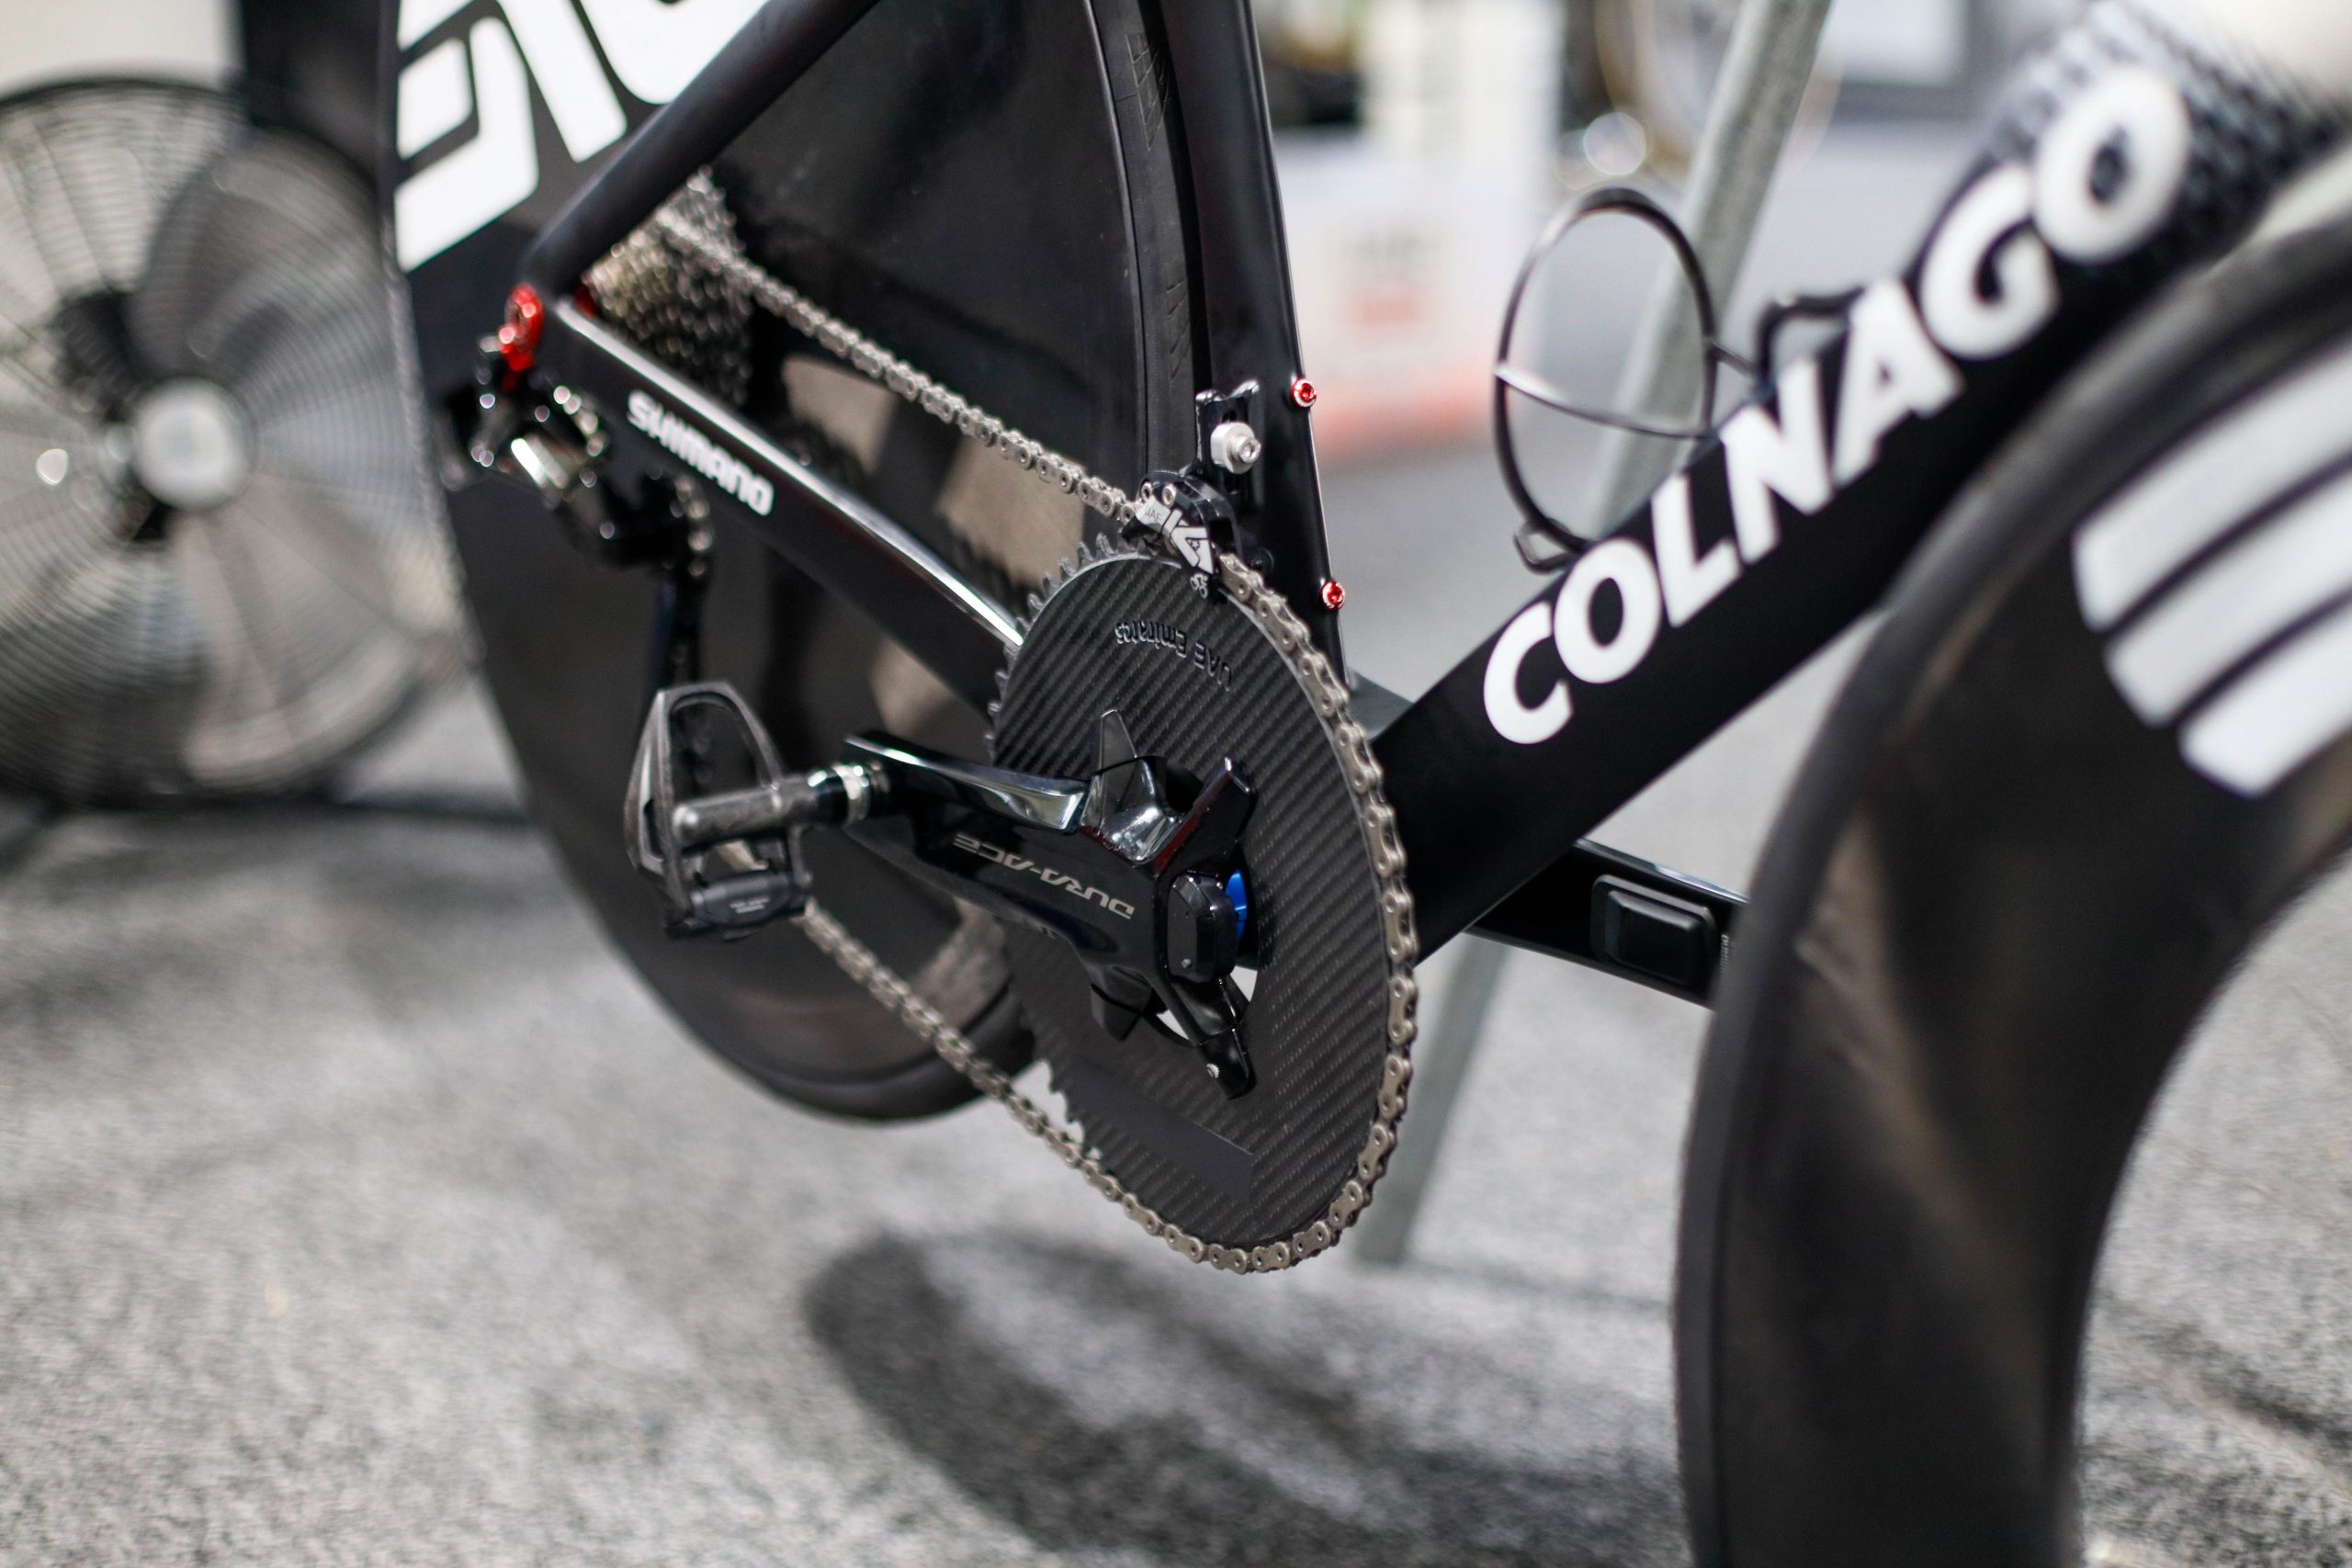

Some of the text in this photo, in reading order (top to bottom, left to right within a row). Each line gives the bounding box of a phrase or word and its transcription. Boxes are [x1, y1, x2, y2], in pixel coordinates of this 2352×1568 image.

[627, 389, 775, 516] SHIMANO
[1484, 64, 2193, 744] COLNAGO
[1114, 620, 1232, 692] UAE Emirates
[952, 832, 1136, 919] DURA-ACE
